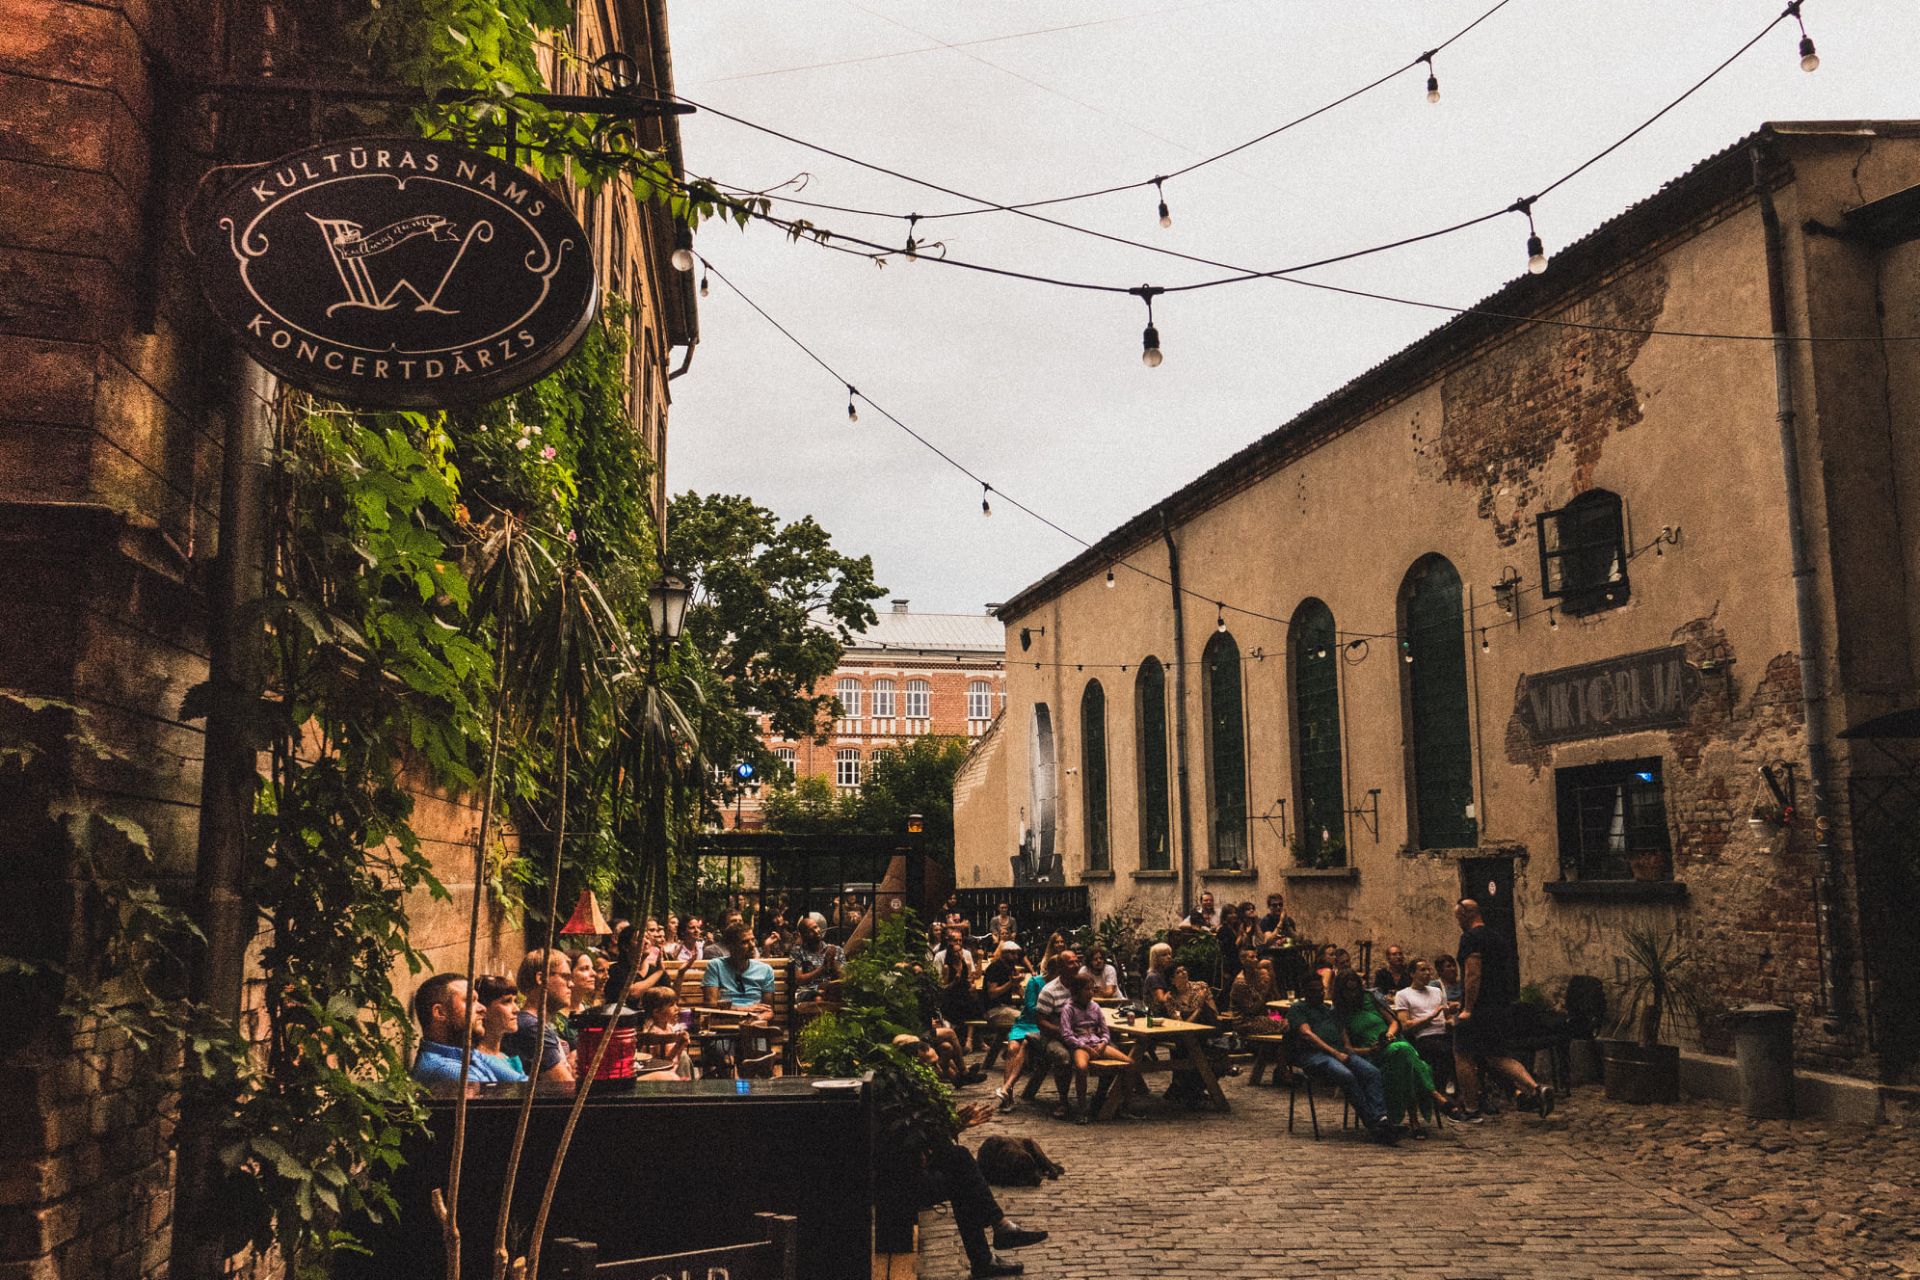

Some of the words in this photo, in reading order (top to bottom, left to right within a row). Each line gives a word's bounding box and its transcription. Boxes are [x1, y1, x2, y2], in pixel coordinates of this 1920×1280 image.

[251, 147, 439, 203] KULTŪRAS
[455, 159, 547, 218] NAMS
[246, 312, 536, 379] KONCERTDĀRZS
